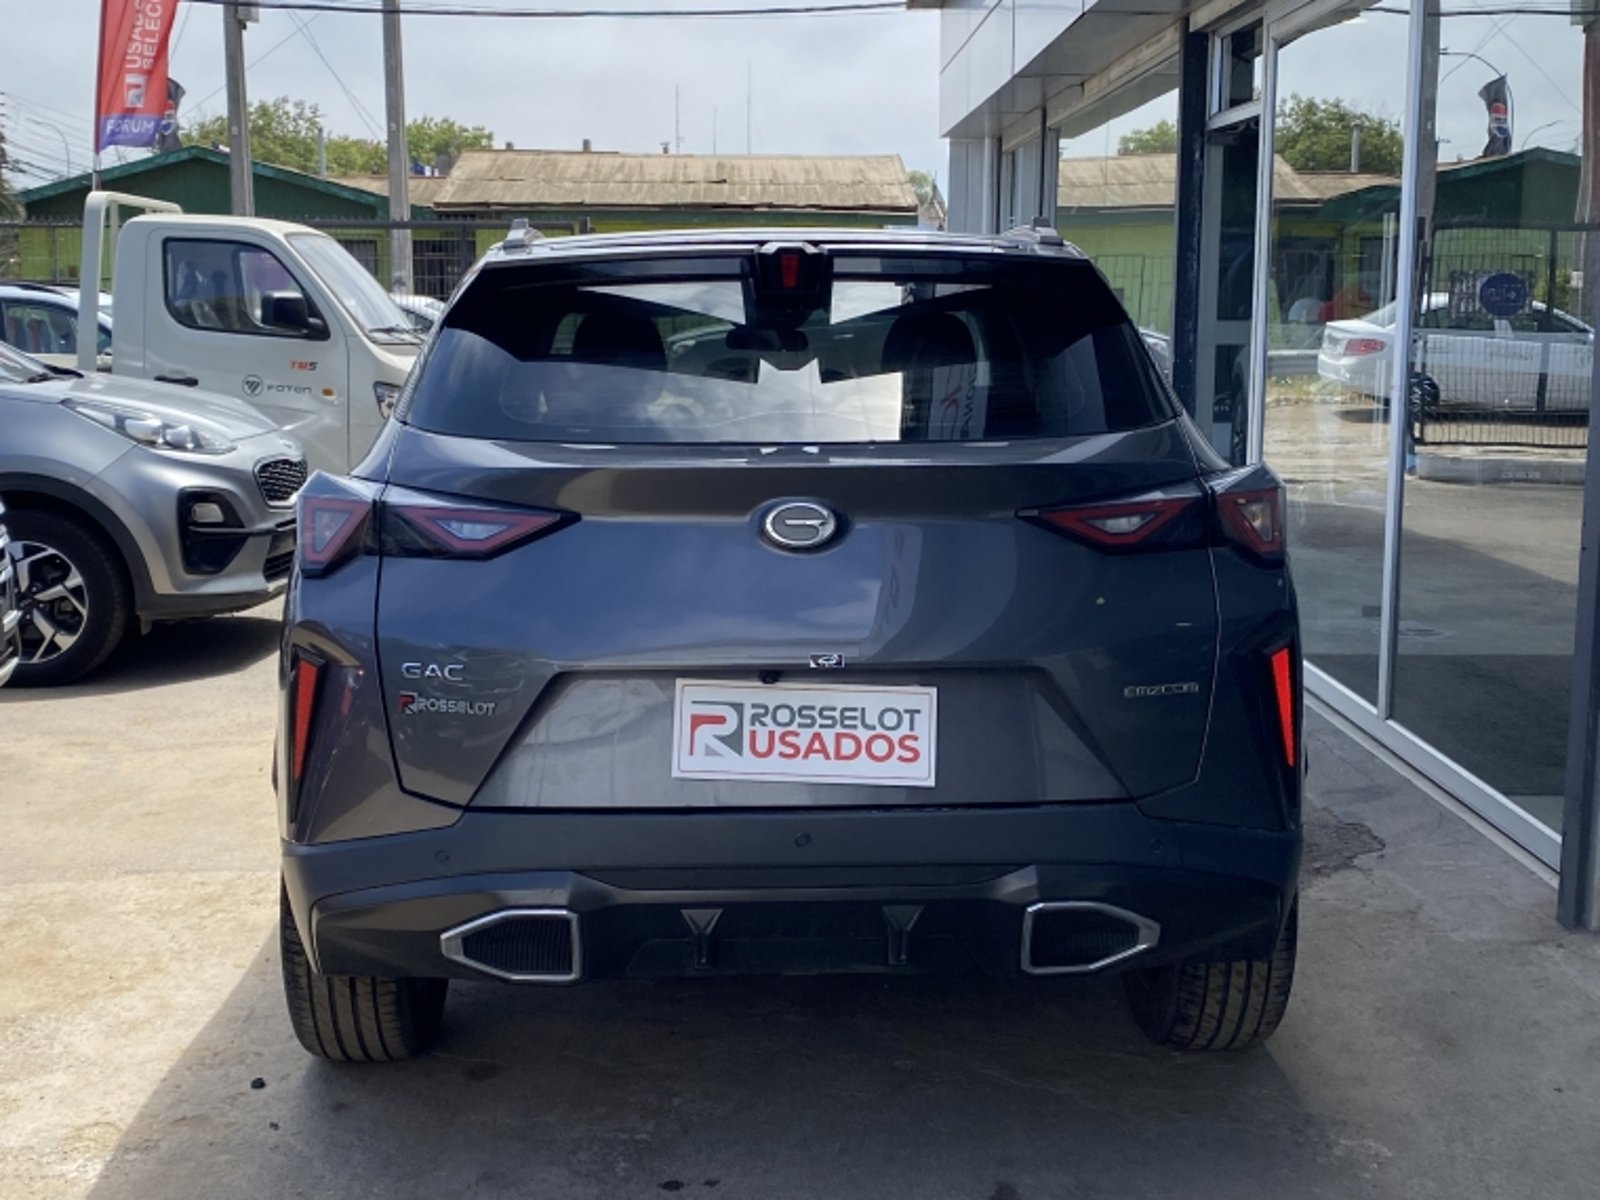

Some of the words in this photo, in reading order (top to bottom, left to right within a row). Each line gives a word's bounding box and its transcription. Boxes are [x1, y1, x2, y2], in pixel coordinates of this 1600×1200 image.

[142, 0, 163, 70] SELEC
[106, 118, 155, 135] FORUM
[401, 662, 464, 681] GAC
[750, 703, 922, 732] ROSSELOT
[748, 730, 921, 763] USADOS
